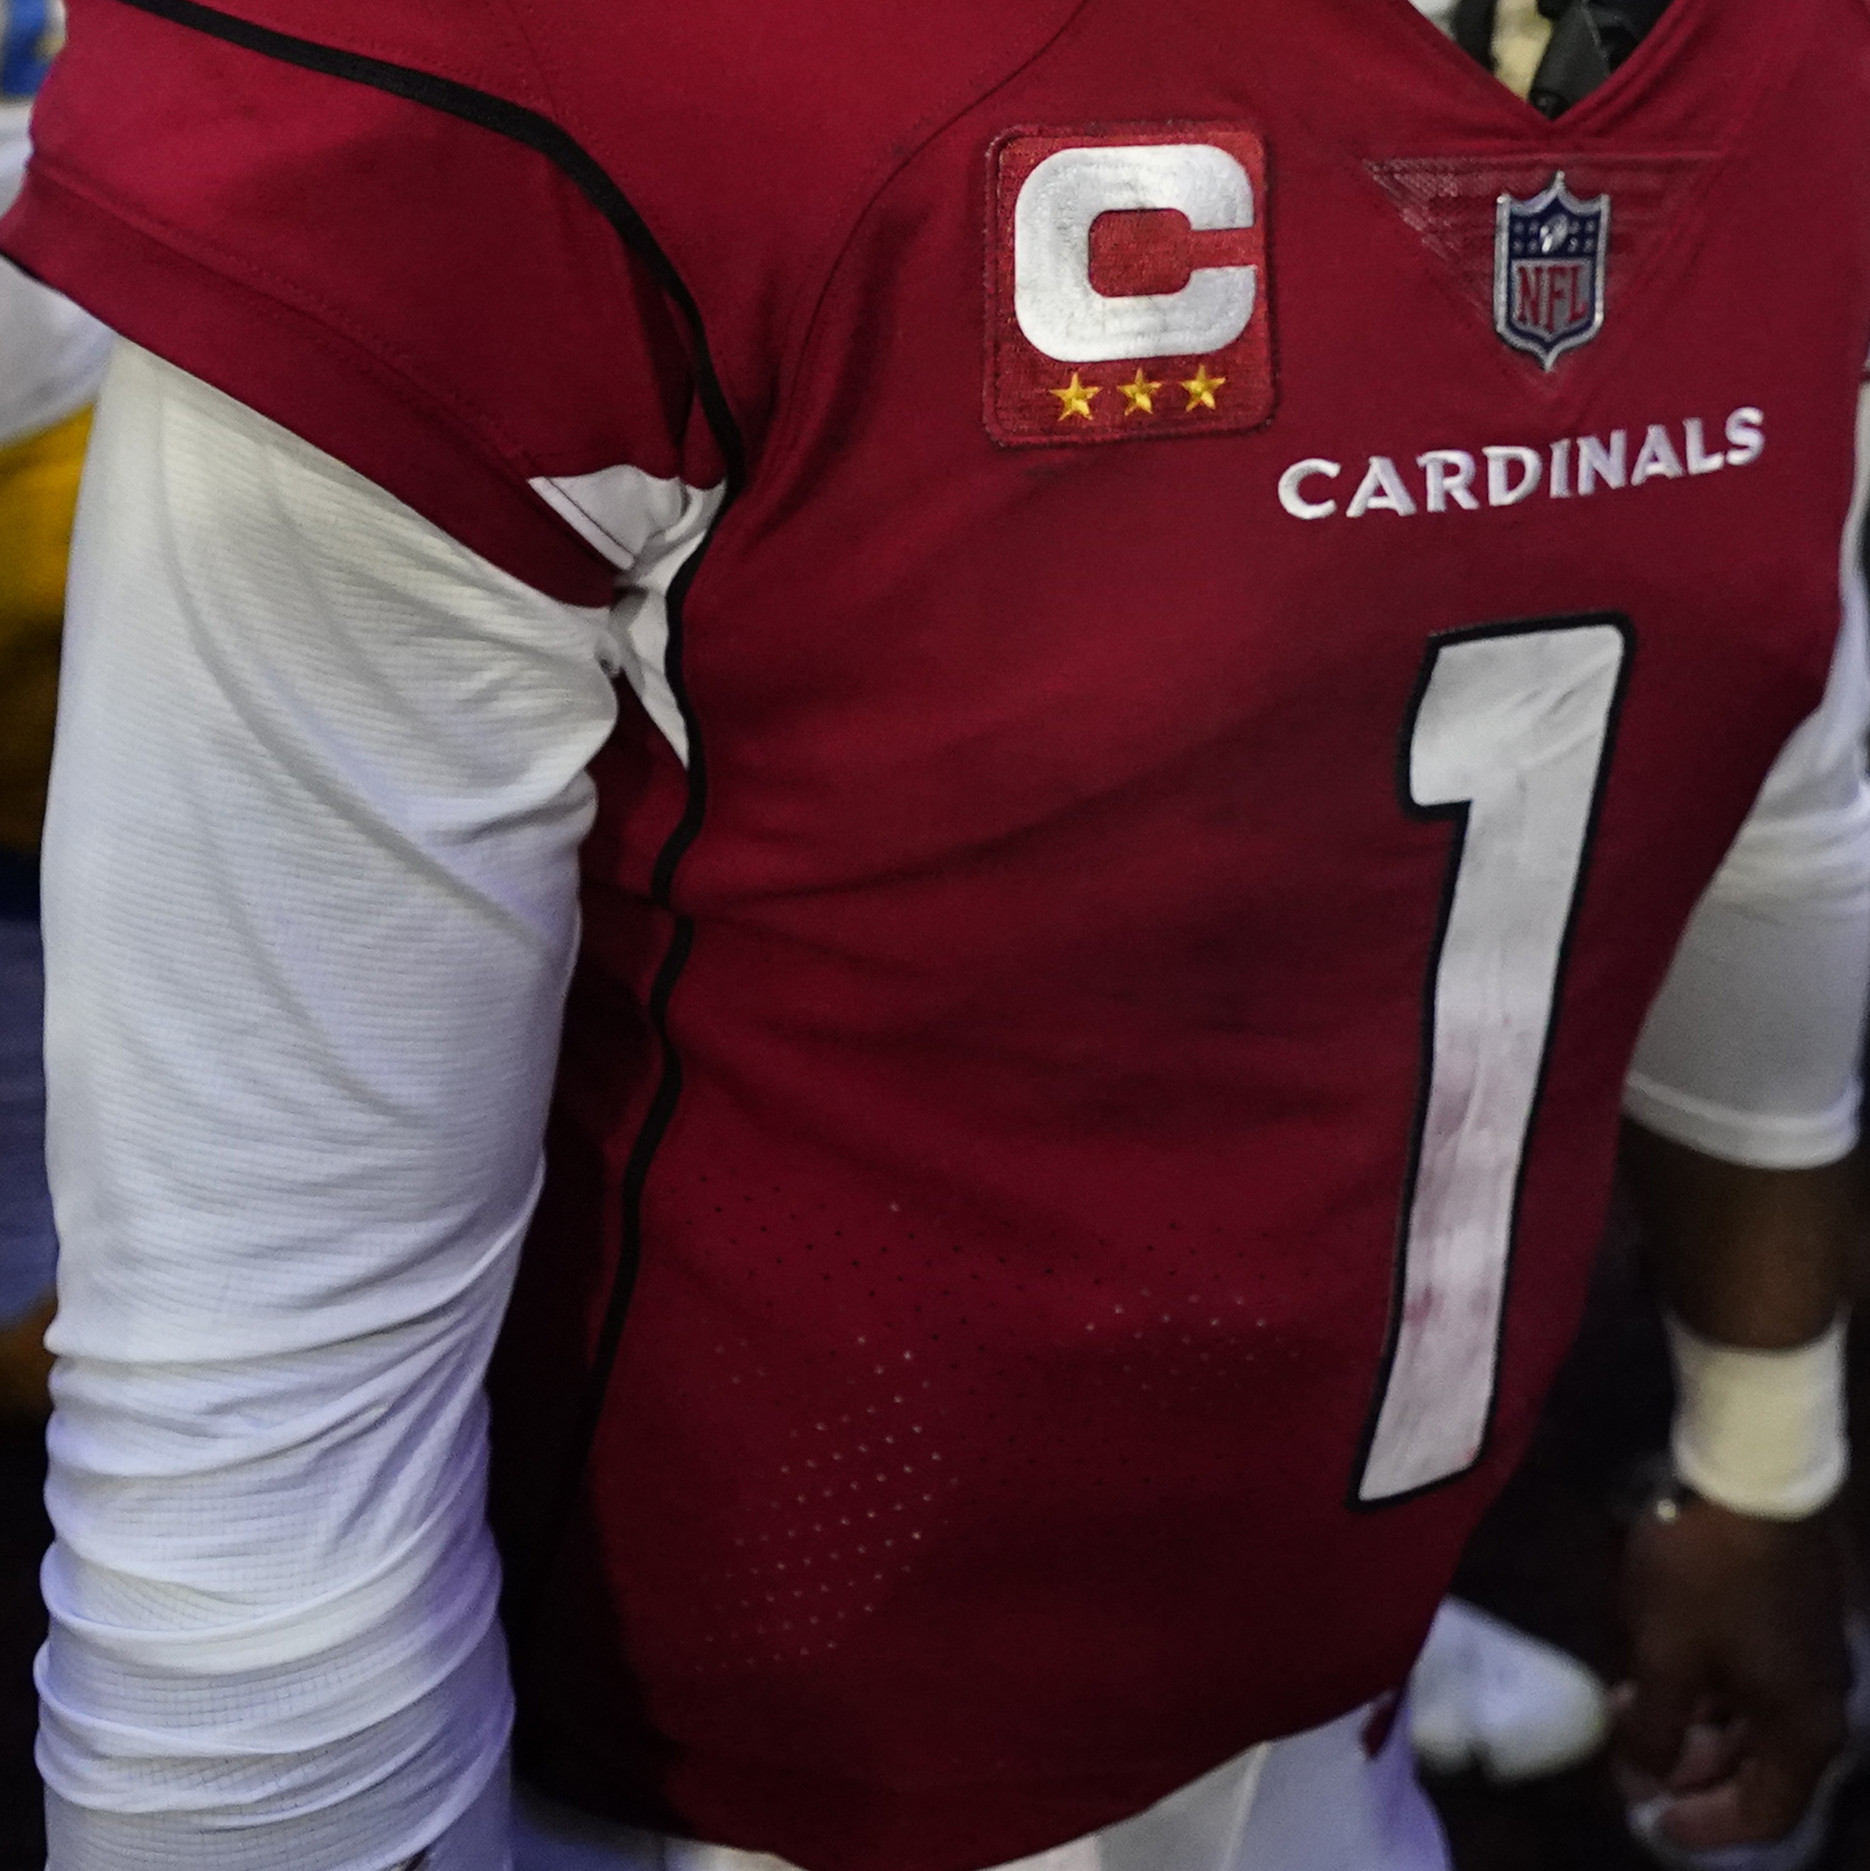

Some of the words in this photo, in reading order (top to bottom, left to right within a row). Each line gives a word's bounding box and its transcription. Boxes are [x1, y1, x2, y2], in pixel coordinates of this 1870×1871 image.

[1013, 142, 1259, 364] C
[1517, 264, 1589, 333] NFL
[1276, 405, 1766, 521] CARDINALS
[1353, 618, 1631, 1506] 1
